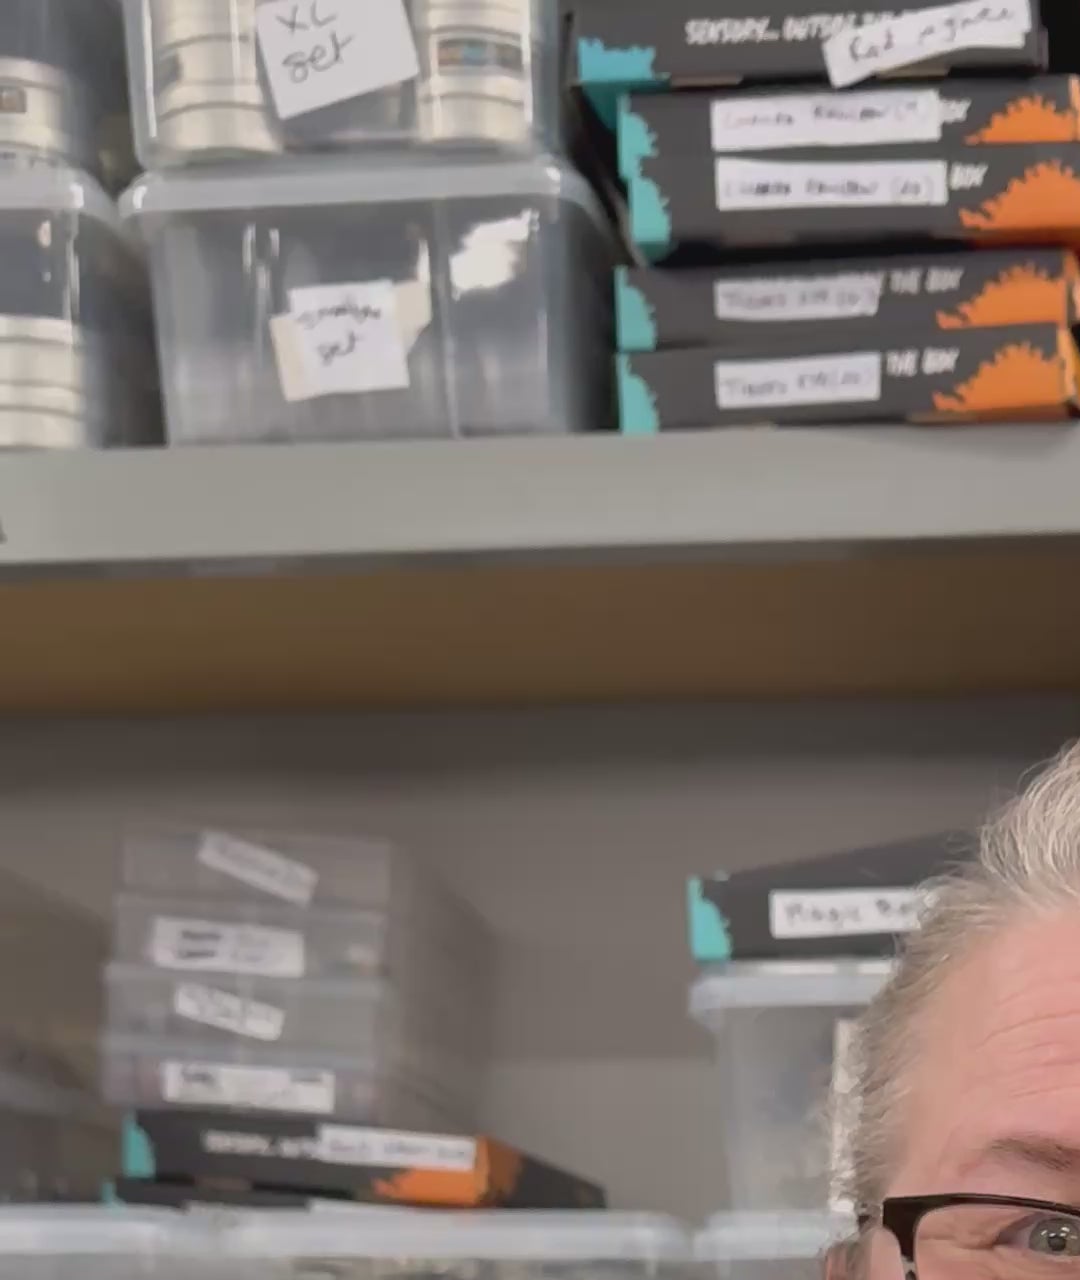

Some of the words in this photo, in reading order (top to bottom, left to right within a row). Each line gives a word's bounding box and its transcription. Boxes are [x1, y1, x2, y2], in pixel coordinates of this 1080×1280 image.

[950, 163, 988, 190] BOX
[890, 268, 922, 295] THE
[925, 267, 964, 293] BOX
[886, 350, 918, 377] THE
[921, 348, 960, 375] BOX
